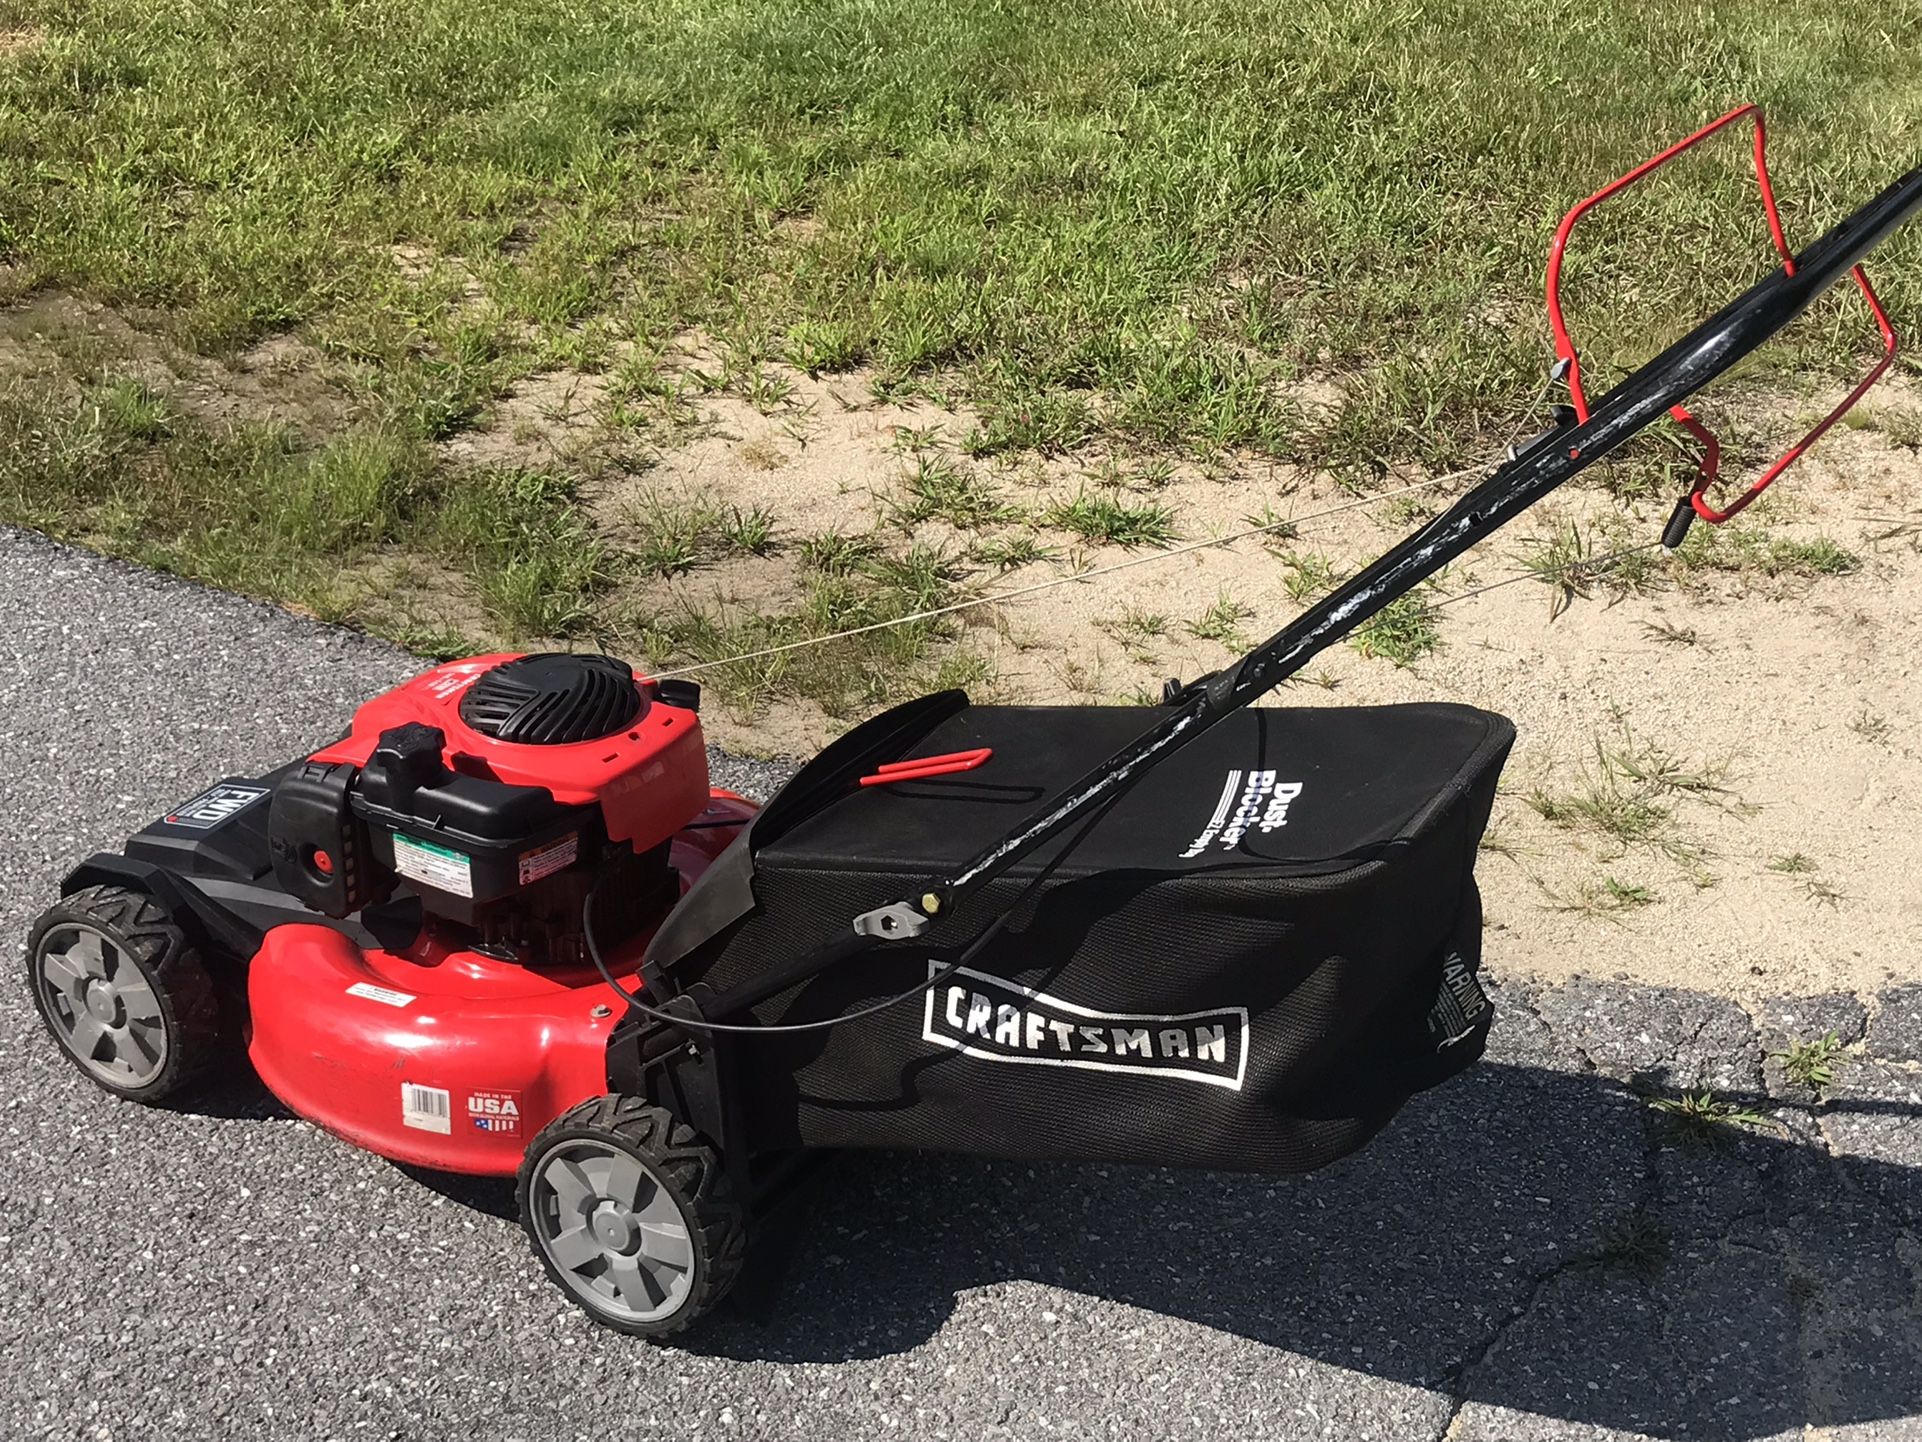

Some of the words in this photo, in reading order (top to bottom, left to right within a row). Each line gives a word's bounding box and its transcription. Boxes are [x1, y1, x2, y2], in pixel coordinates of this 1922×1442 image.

[192, 790, 260, 820] FWD
[945, 986, 1226, 1063] CRAFTSMAN
[468, 1096, 519, 1115] USA
